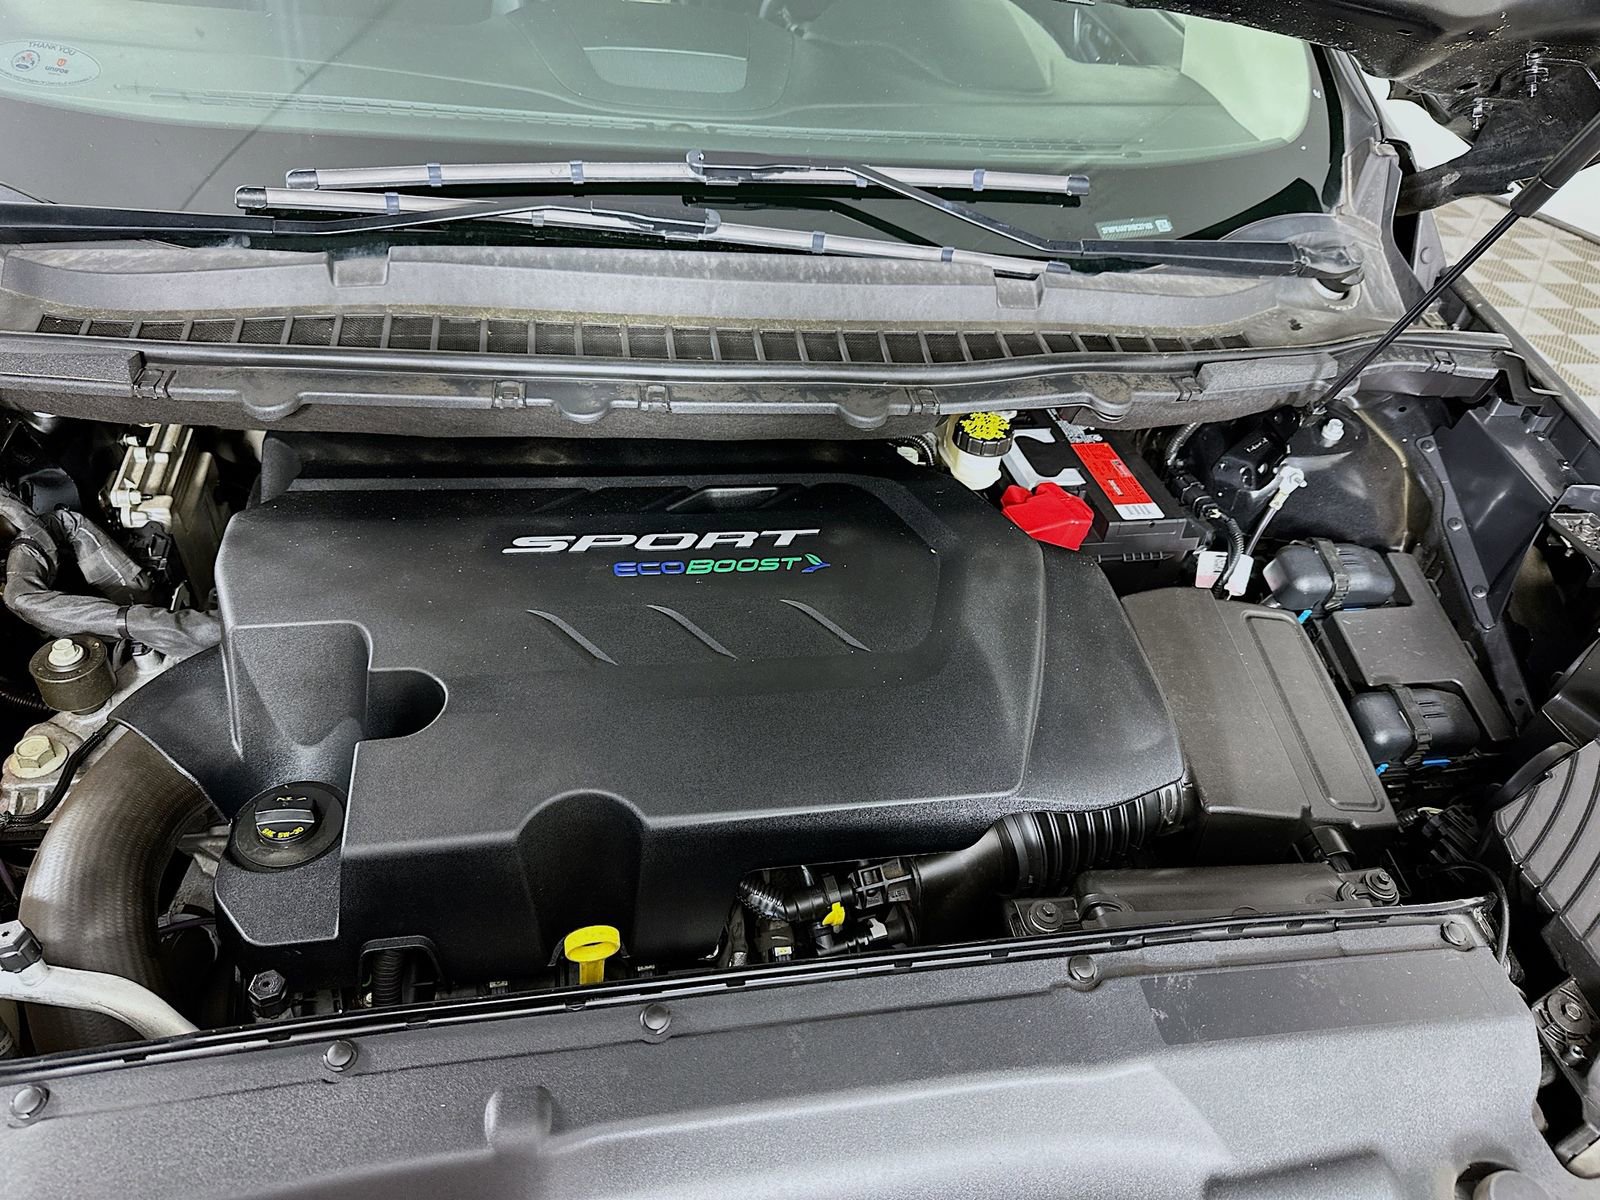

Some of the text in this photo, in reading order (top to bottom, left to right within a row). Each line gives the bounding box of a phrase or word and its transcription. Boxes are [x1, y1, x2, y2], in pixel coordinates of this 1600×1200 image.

[28, 41, 76, 56] THANK YOU
[502, 528, 820, 554] SPORT
